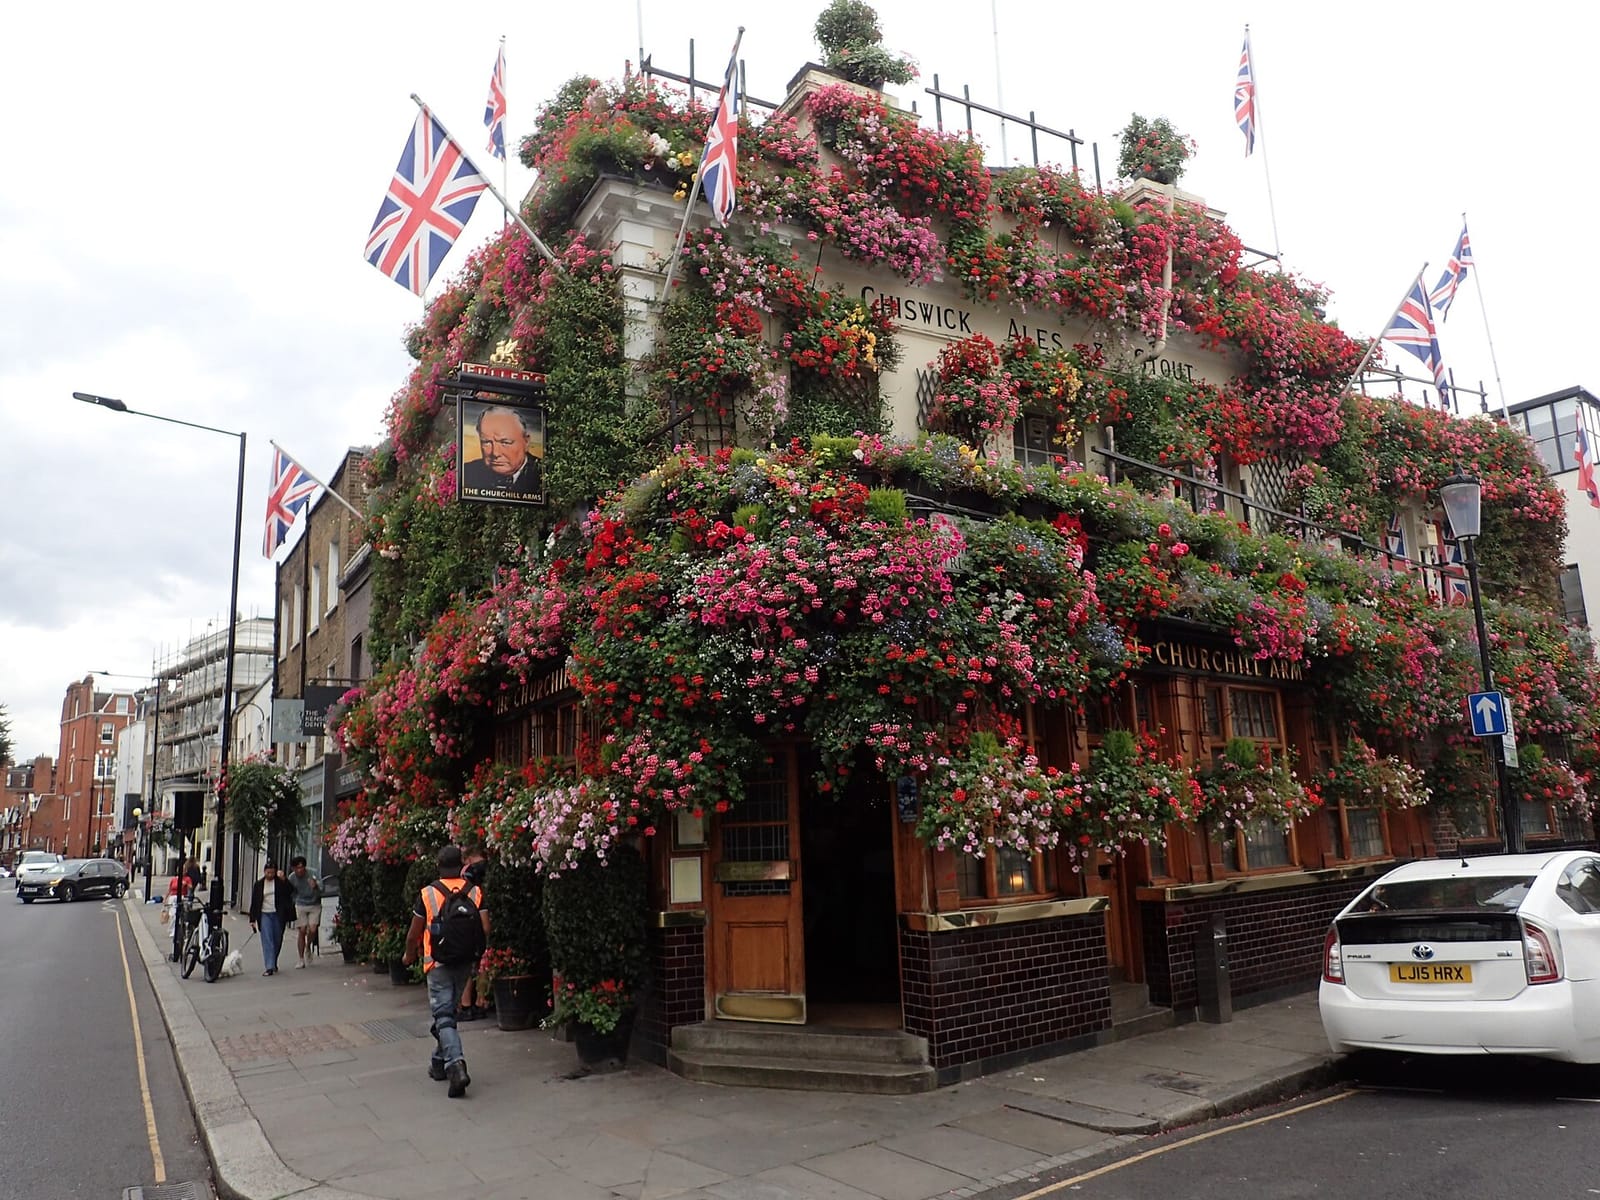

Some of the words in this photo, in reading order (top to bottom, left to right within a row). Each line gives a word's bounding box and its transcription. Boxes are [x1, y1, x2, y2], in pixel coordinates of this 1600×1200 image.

[861, 286, 971, 333] CHISWICK
[1007, 318, 1063, 352] ALES
[481, 489, 520, 499] CHURCHILL
[522, 493, 541, 501] ARMS
[1155, 642, 1262, 677] CHURCHILL
[1269, 655, 1303, 681] ARM
[1398, 966, 1430, 980] LJ15
[1433, 966, 1464, 980] HRX
